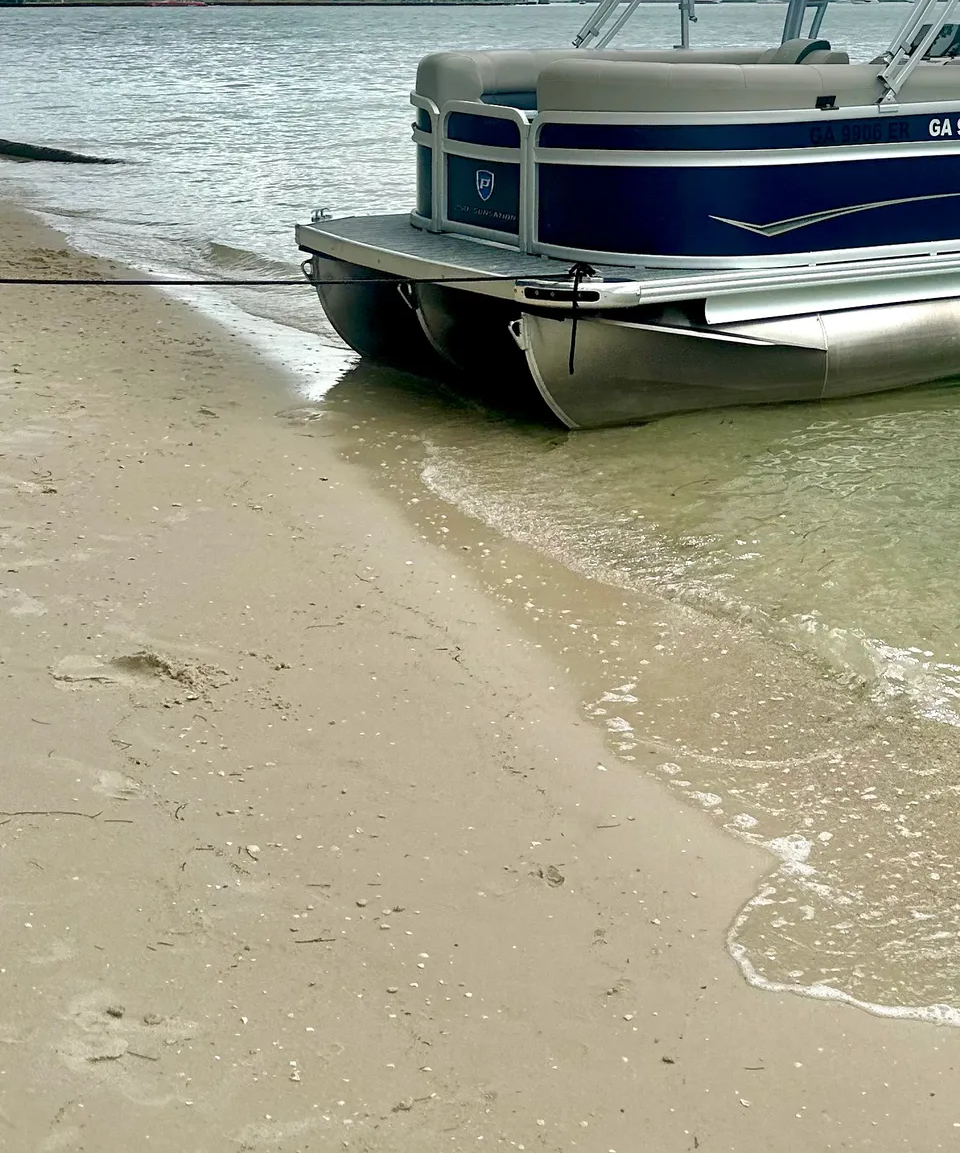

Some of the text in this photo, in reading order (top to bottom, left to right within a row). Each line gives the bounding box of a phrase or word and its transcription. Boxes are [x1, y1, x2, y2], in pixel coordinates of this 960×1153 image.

[809, 121, 910, 145] GA 9906 ER
[929, 119, 952, 136] GA
